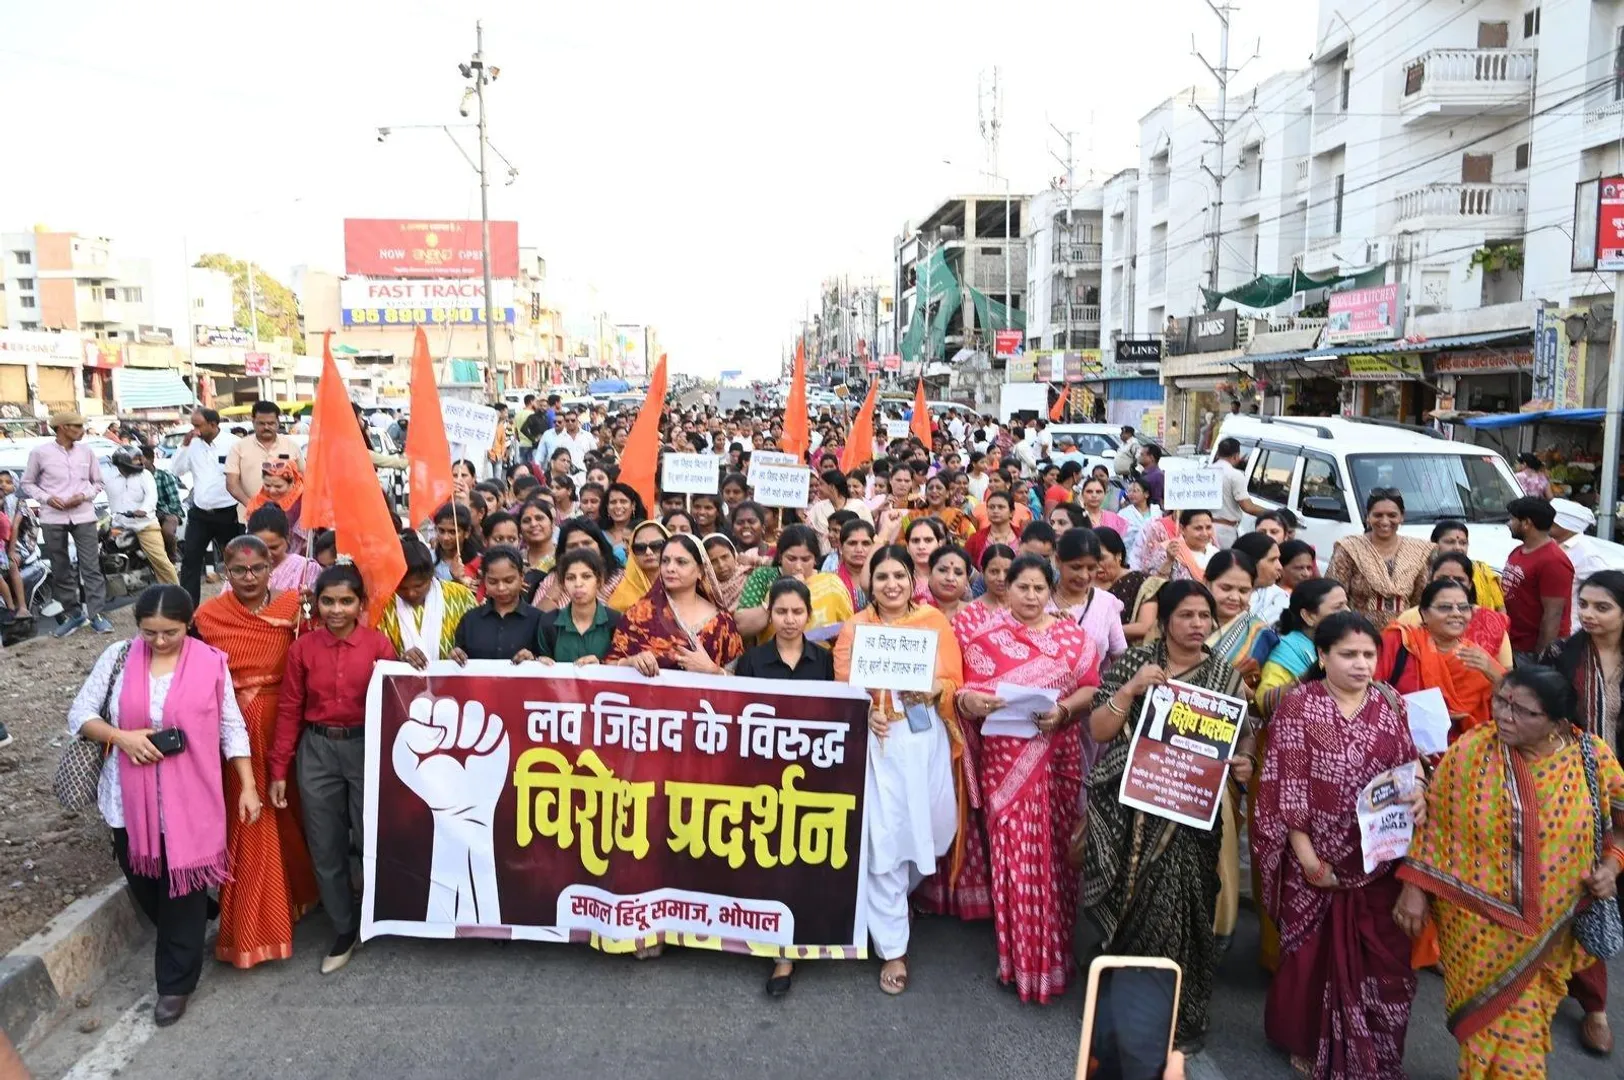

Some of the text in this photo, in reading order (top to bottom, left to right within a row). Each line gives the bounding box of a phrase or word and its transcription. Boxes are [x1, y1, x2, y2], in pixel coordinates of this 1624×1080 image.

[380, 249, 404, 261] NOW
[368, 284, 486, 298] FAST TRACK
[1363, 286, 1397, 304] KITCHEN
[1131, 346, 1158, 355] LINES
[523, 691, 851, 768] लव जिहाद के विरुद्ध
[1168, 701, 1237, 744] विरोध प्रदर्शन
[513, 747, 856, 877] विरोध प्रदर्शन
[1381, 811, 1405, 824] LOVE
[570, 895, 781, 933] सकल हिंदू समाज, भोपाल
